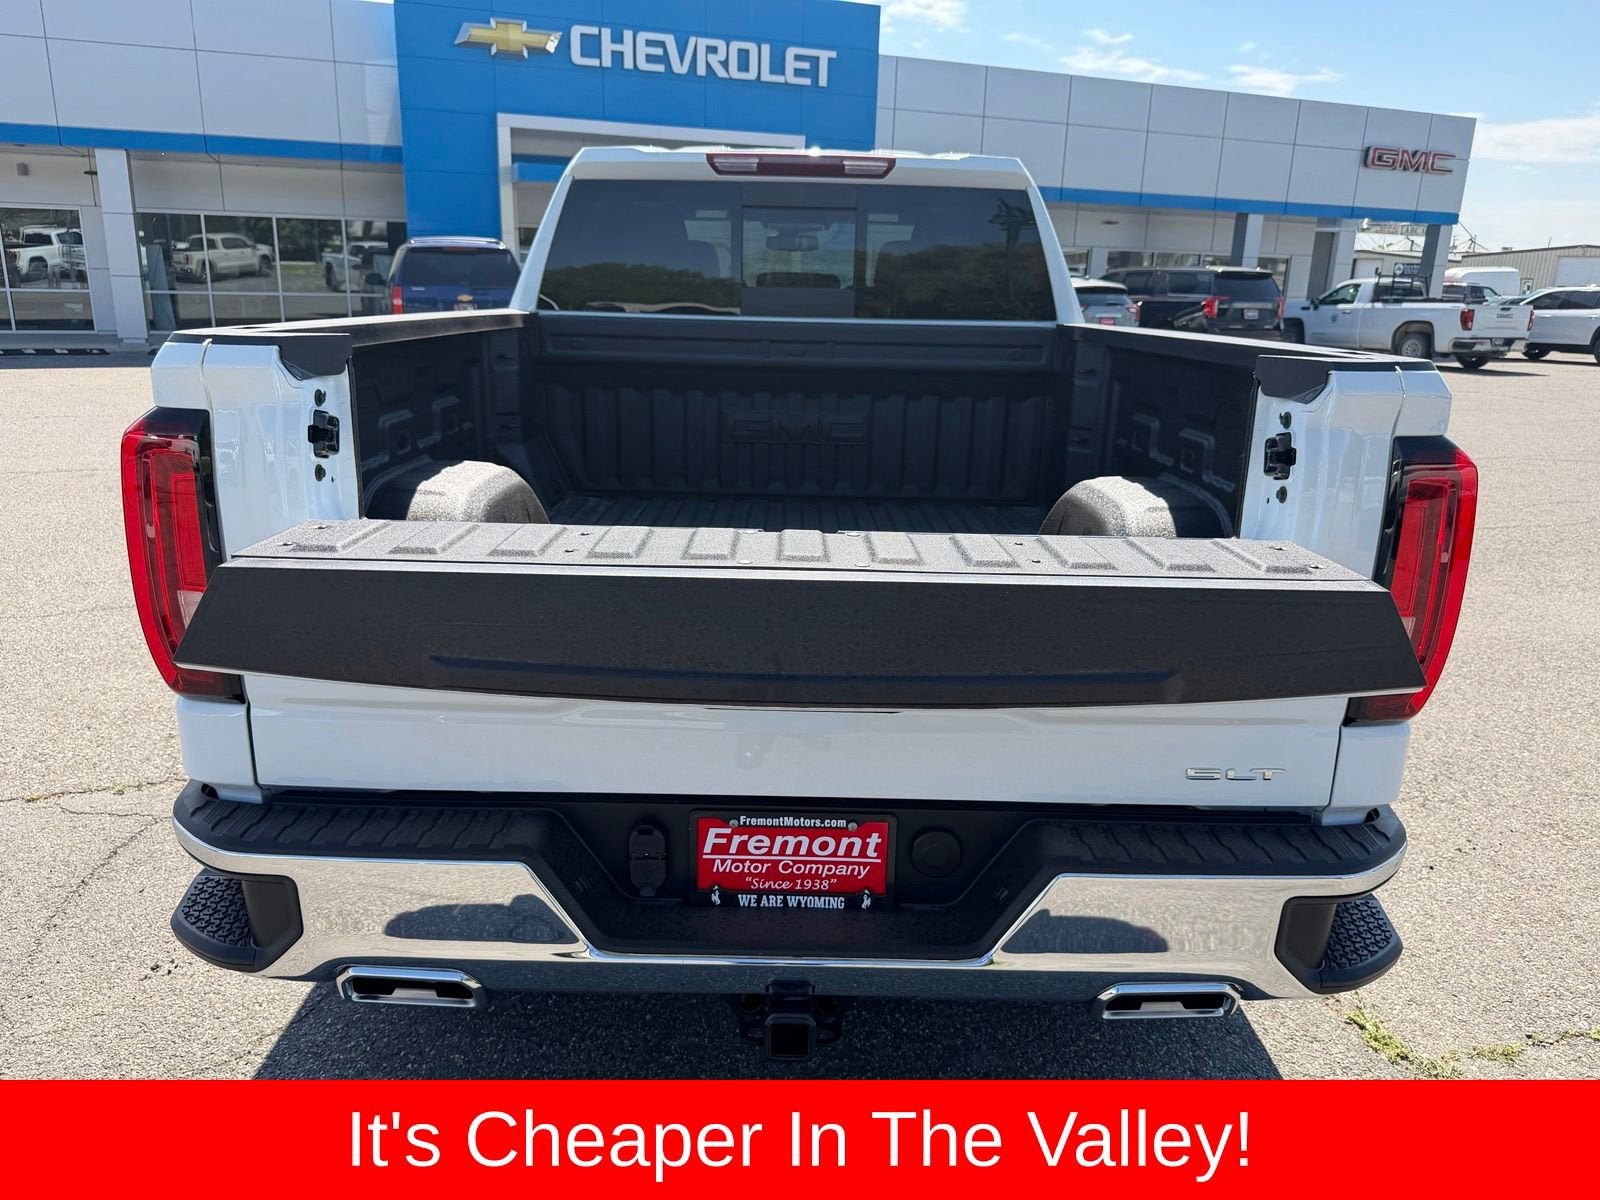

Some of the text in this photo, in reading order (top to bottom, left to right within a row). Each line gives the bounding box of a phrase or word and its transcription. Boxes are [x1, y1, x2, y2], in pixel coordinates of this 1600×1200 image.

[570, 24, 838, 88] CHEVROLET
[1366, 145, 1456, 175] GMC
[727, 412, 866, 443] GMC
[1185, 767, 1288, 781] SLT
[739, 815, 847, 827] FremontMotors.com
[703, 828, 882, 857] Fremont
[712, 859, 870, 879] Motor Company
[737, 894, 845, 910] WE ARE WYOMING
